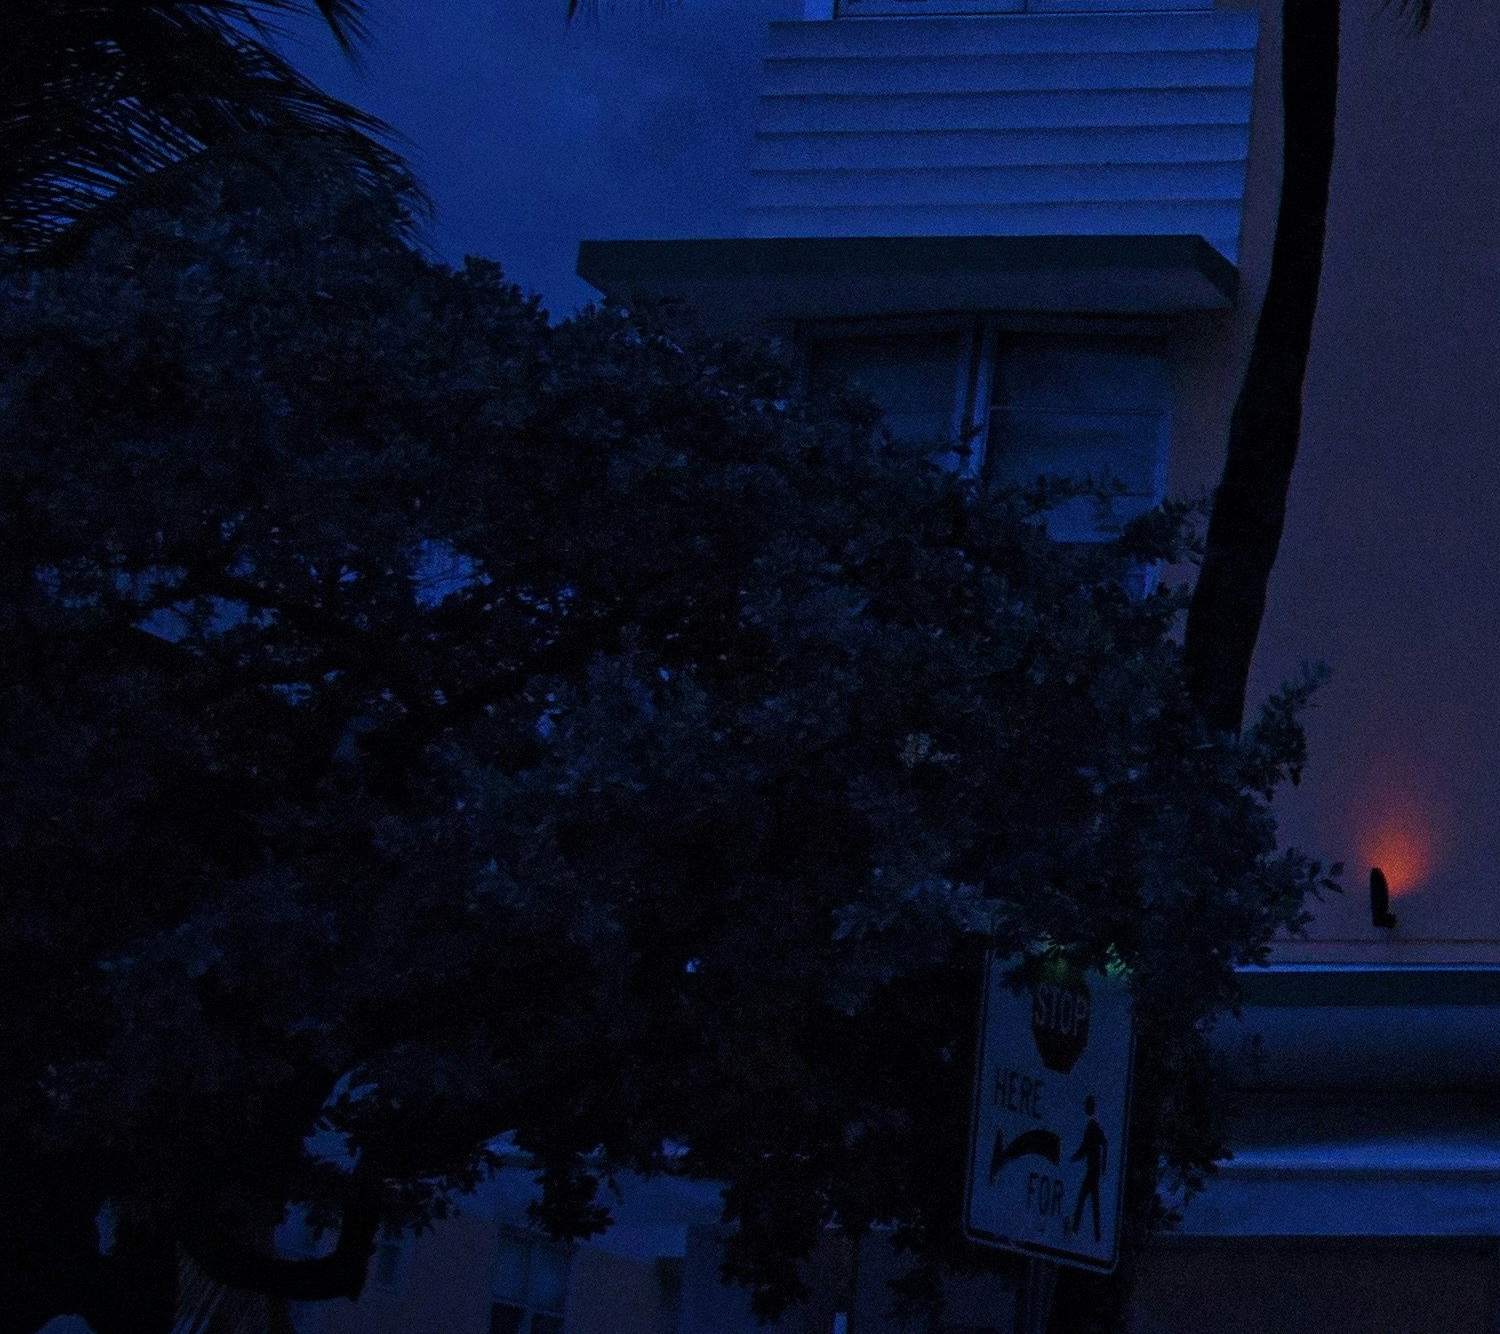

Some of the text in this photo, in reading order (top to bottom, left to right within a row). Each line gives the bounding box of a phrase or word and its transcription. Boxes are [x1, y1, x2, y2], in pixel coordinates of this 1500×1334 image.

[1034, 983, 1088, 1036] STOP
[994, 1068, 1045, 1120] HERE
[1027, 1172, 1064, 1217] FOR
